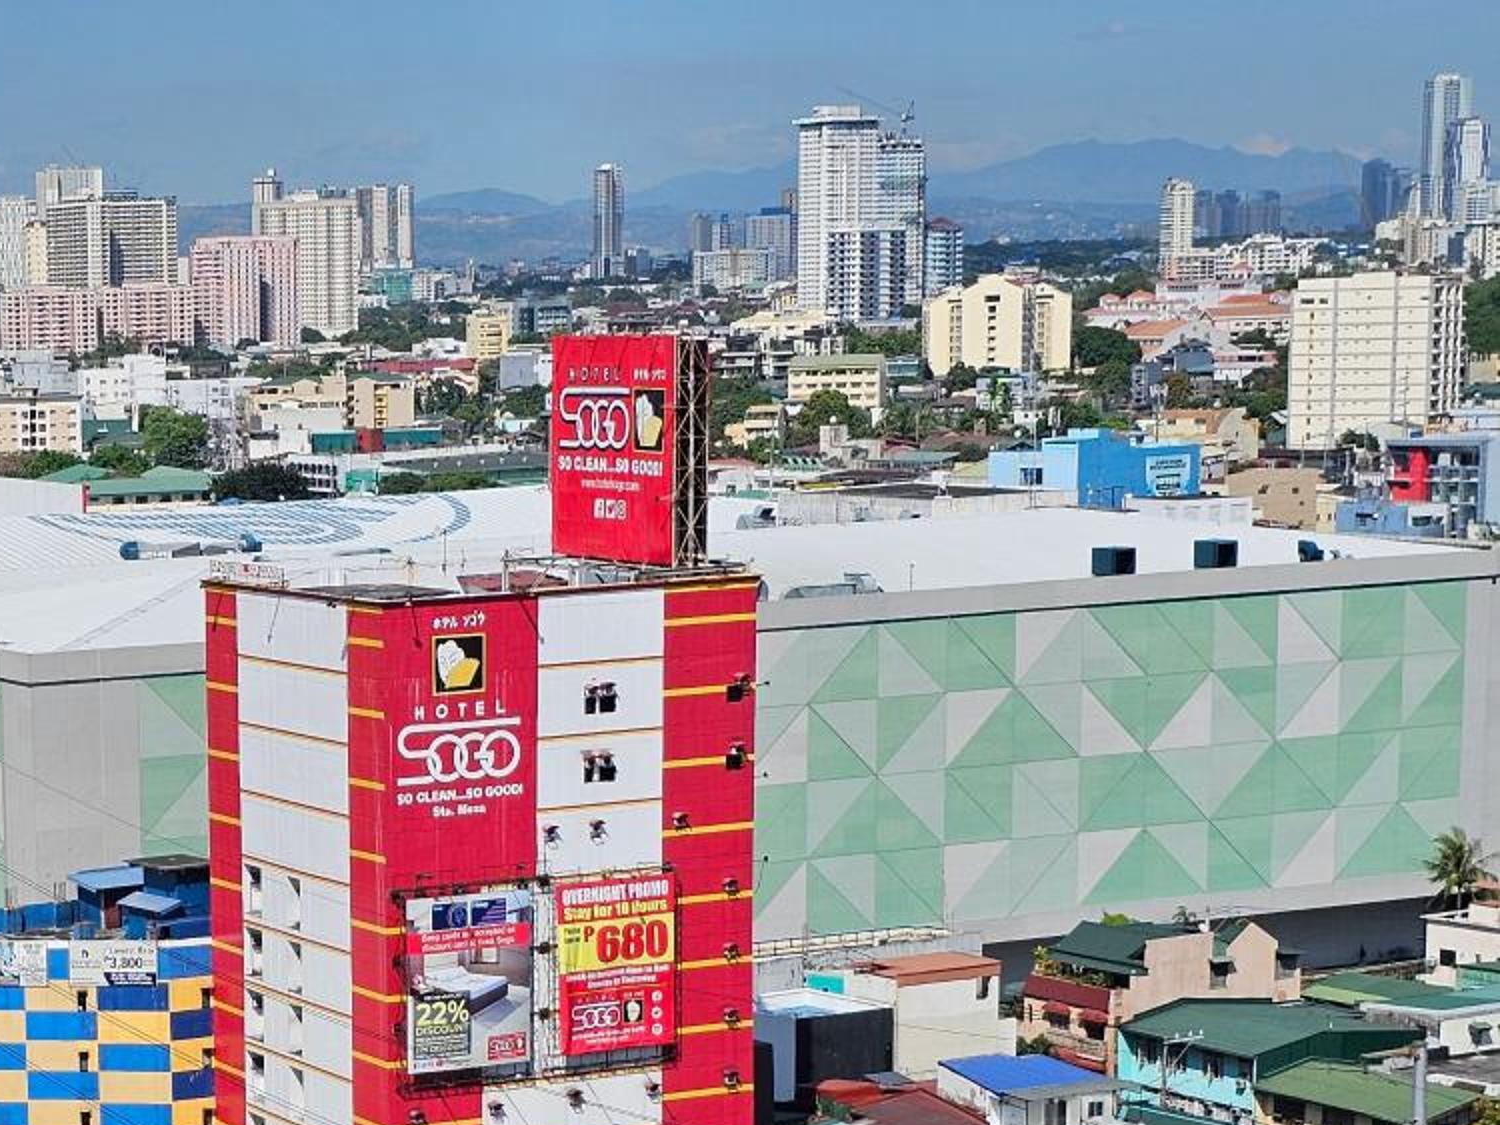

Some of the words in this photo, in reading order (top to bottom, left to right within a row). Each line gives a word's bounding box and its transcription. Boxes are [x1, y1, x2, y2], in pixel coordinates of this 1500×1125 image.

[560, 386, 631, 450] SOGO
[414, 699, 507, 721] HOTEL
[397, 716, 521, 787] SOGO
[396, 792, 413, 806] SO
[561, 883, 627, 908] OVERNIGHT
[628, 879, 669, 899] PROMO
[563, 907, 592, 922] Stay
[631, 899, 668, 915] Hours
[416, 999, 469, 1028] 22%
[572, 1000, 622, 1032] SOGO
